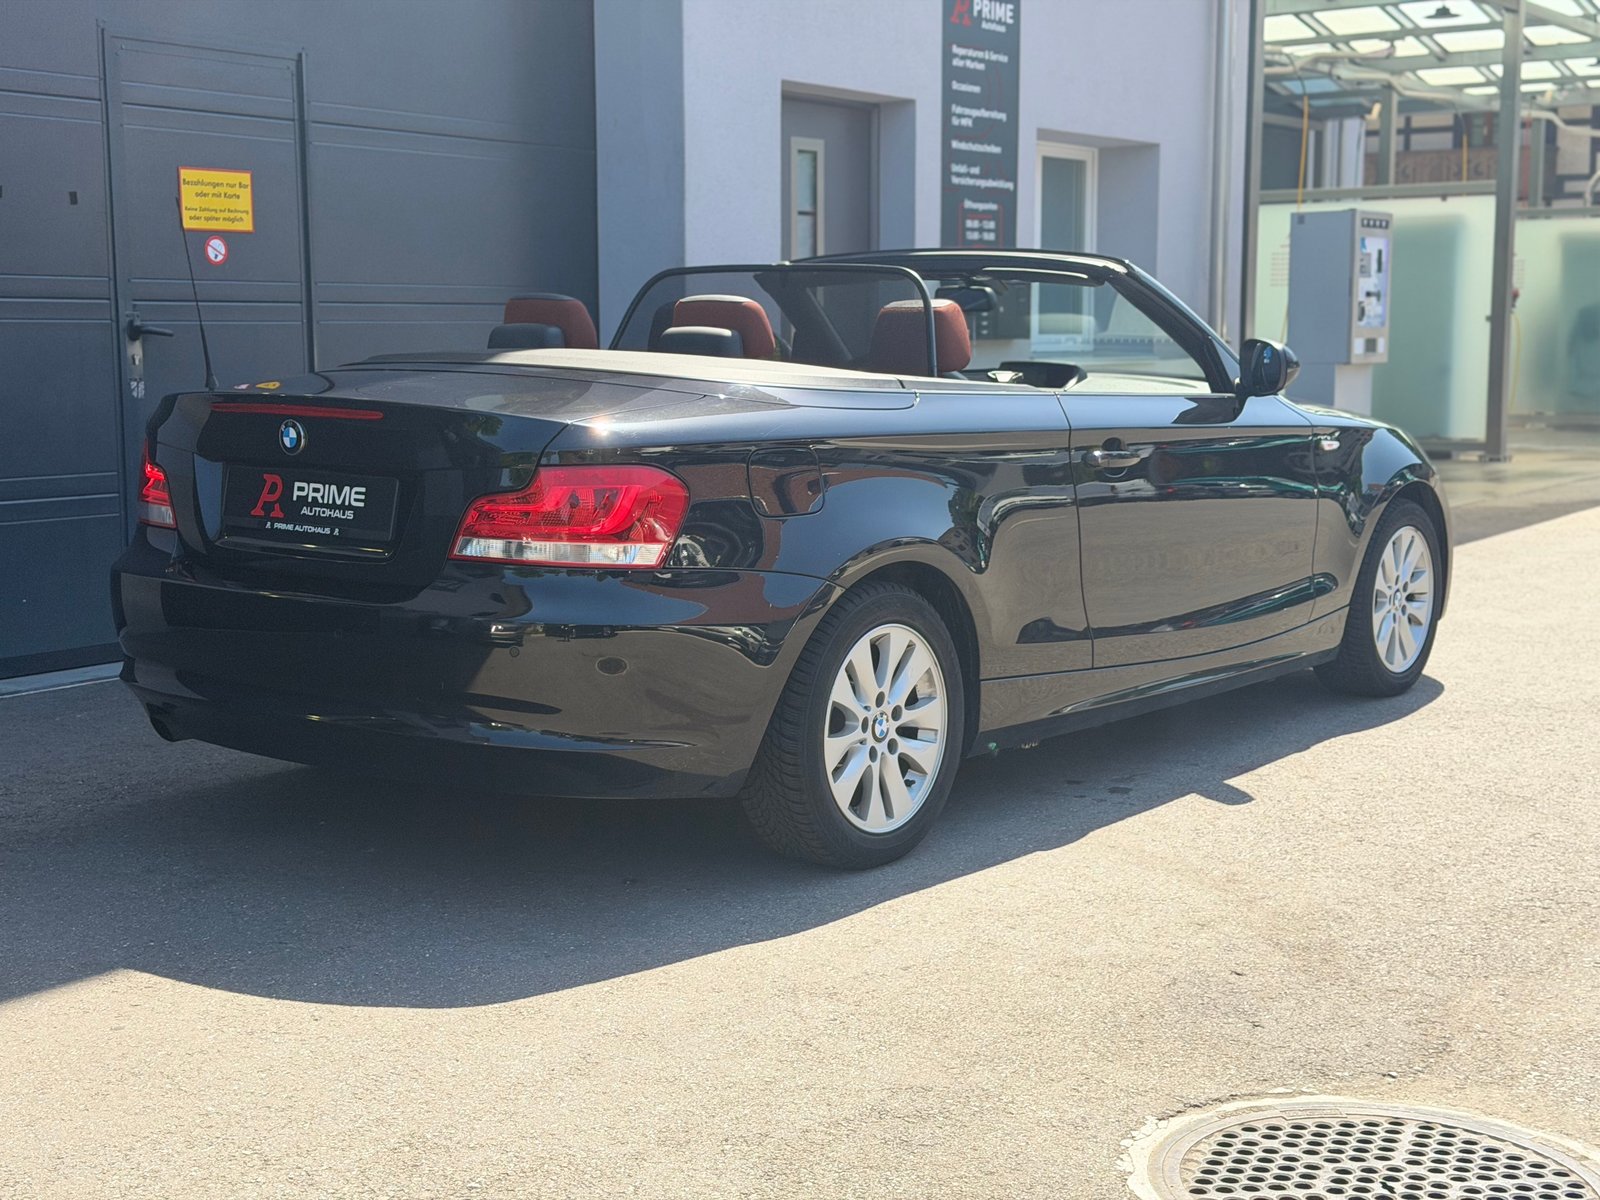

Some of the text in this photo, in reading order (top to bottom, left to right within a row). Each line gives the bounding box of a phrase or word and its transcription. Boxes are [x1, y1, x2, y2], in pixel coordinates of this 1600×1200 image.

[973, 0, 1014, 24] PRIME
[183, 178, 225, 188] Bezahlungen
[238, 181, 249, 189] Bar
[194, 190, 210, 198] oder
[293, 481, 366, 507] PRIME
[300, 506, 354, 520] AUTOHAUS
[273, 522, 331, 534] PRIME AUTOHAUS
